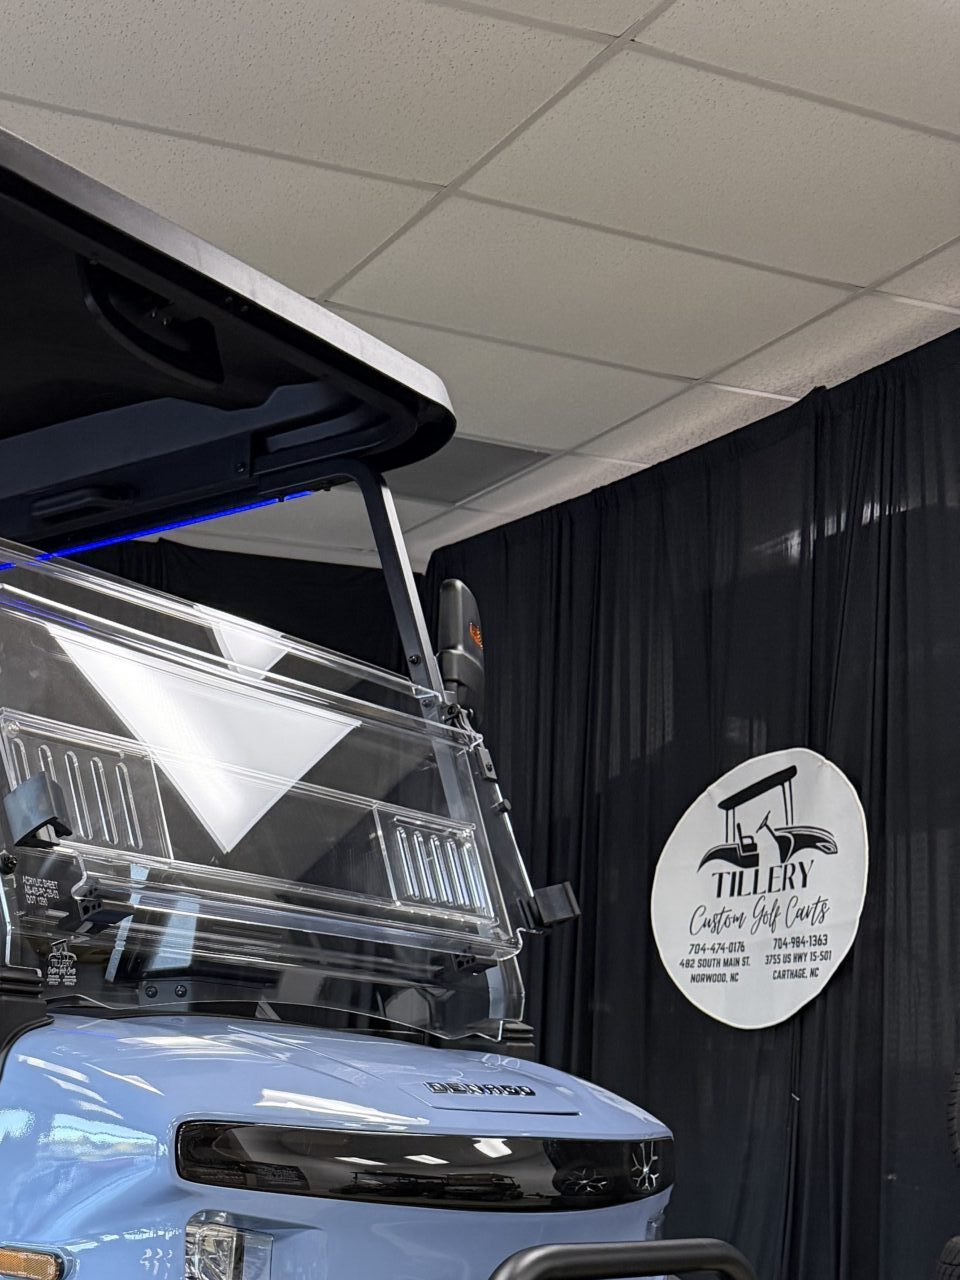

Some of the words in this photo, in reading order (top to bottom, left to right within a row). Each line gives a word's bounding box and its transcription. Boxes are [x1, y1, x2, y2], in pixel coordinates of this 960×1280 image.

[712, 860, 814, 898] TILLERY
[689, 904, 746, 936] Custom
[750, 895, 781, 935] Golf
[785, 895, 830, 928] Carts
[688, 941, 745, 954] 704-474-0176
[773, 934, 828, 950] 704-984-1363
[697, 958, 721, 968] SOUTH
[723, 957, 740, 967] MAIN
[782, 953, 792, 963] US
[793, 952, 808, 963] HWY
[810, 950, 832, 962] 15-501
[730, 972, 739, 982] NC
[809, 967, 820, 978] NC
[423, 1081, 536, 1097] DENAGO
